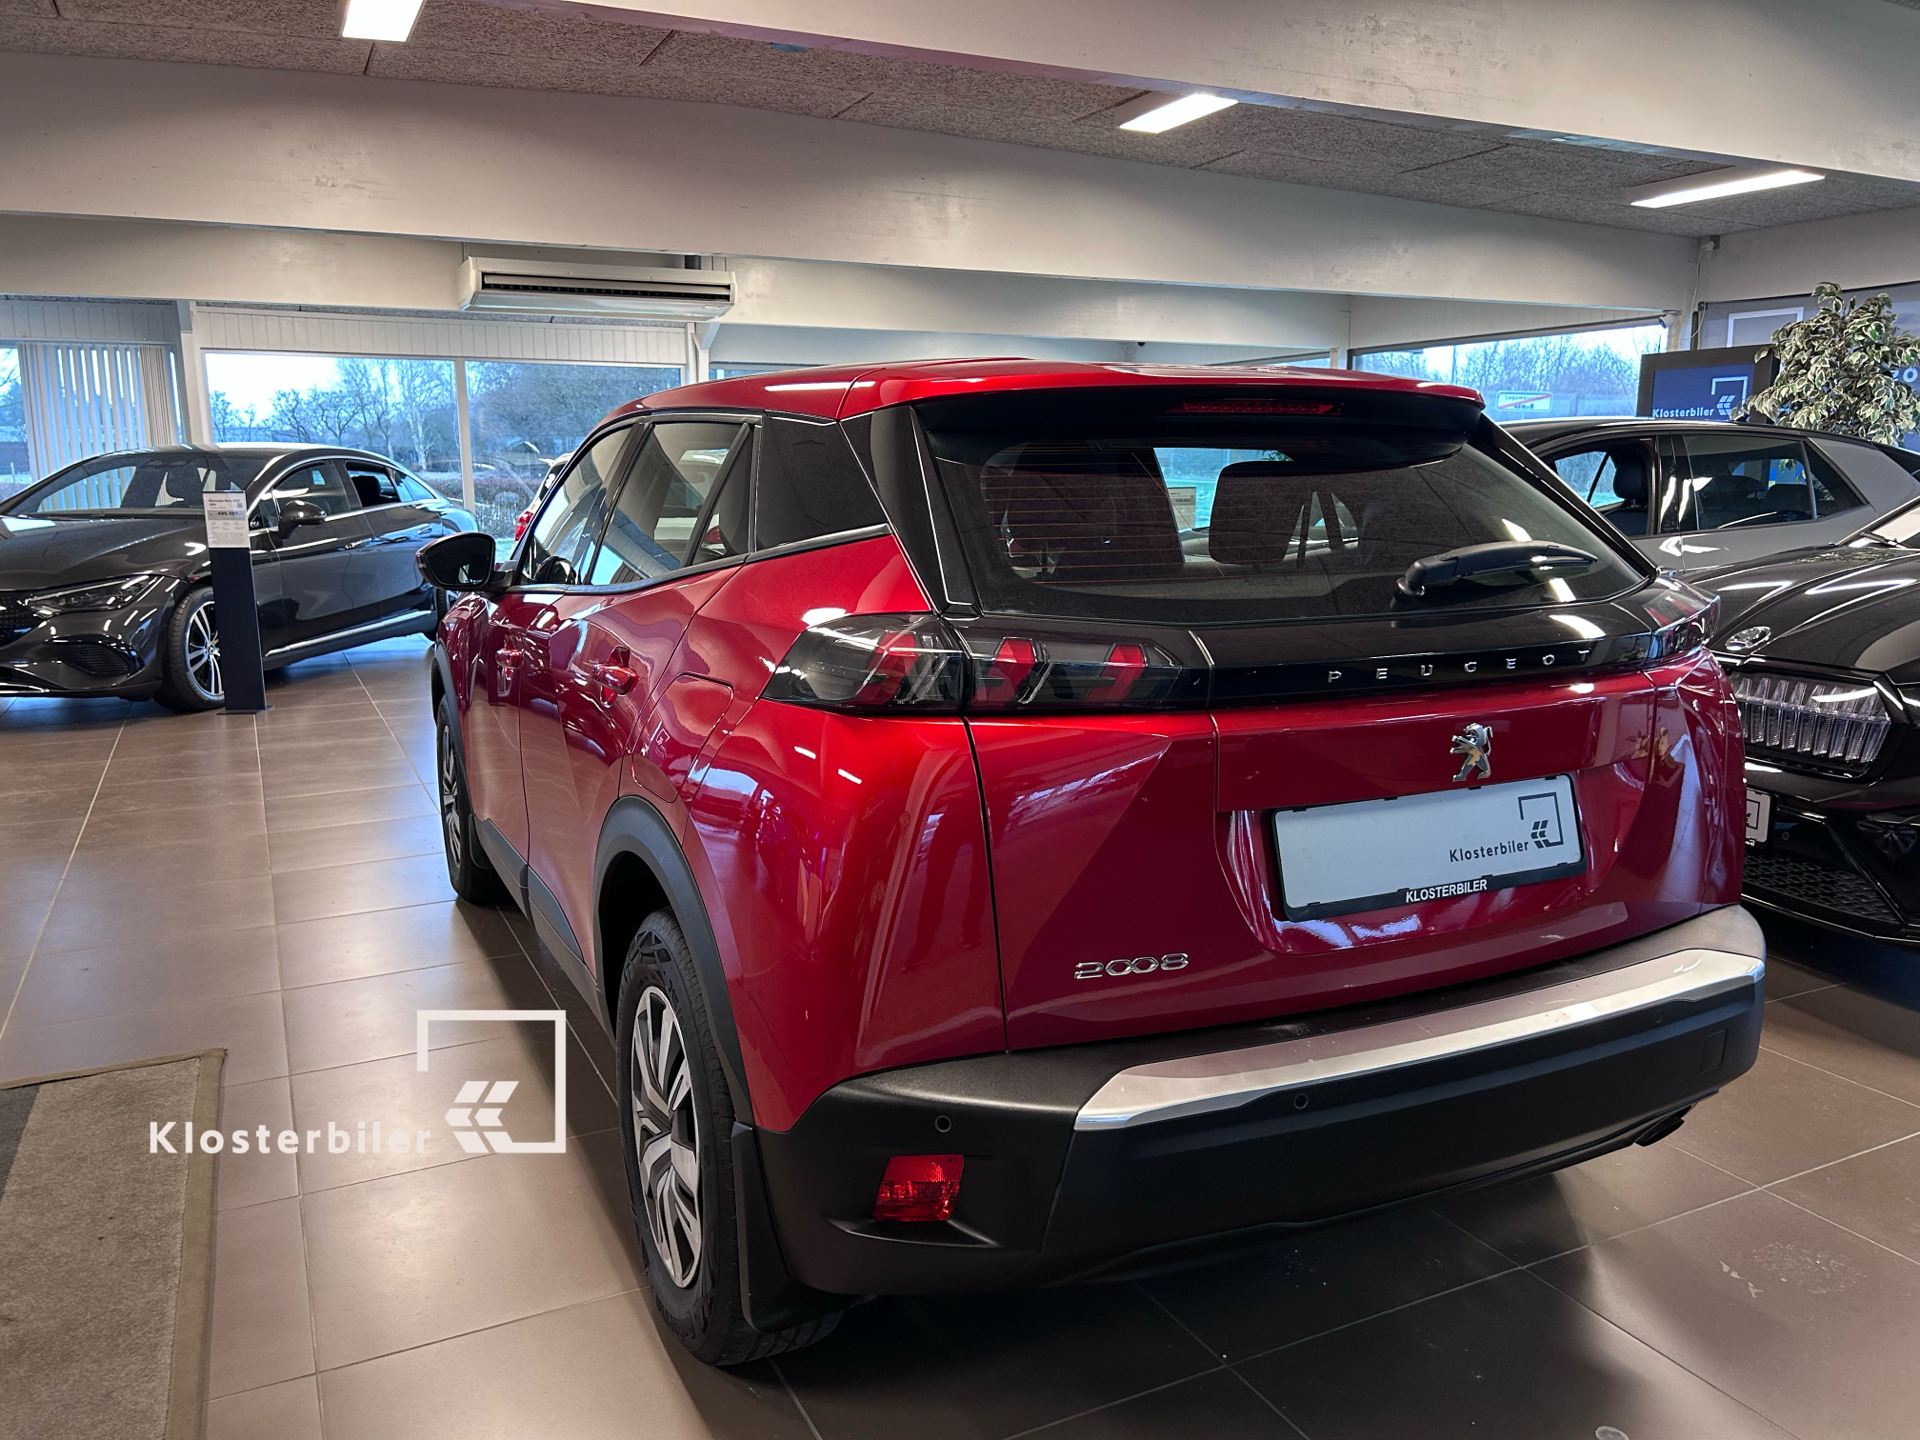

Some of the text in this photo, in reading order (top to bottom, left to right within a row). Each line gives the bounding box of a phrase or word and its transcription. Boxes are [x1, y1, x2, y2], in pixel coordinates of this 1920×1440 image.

[1652, 407, 1715, 418] Klosterbiler
[1328, 650, 1590, 683] PEUGEOT
[1449, 840, 1529, 862] Klosterbiler
[1405, 879, 1488, 903] KLOSTERBILER
[1074, 953, 1189, 979] 2008
